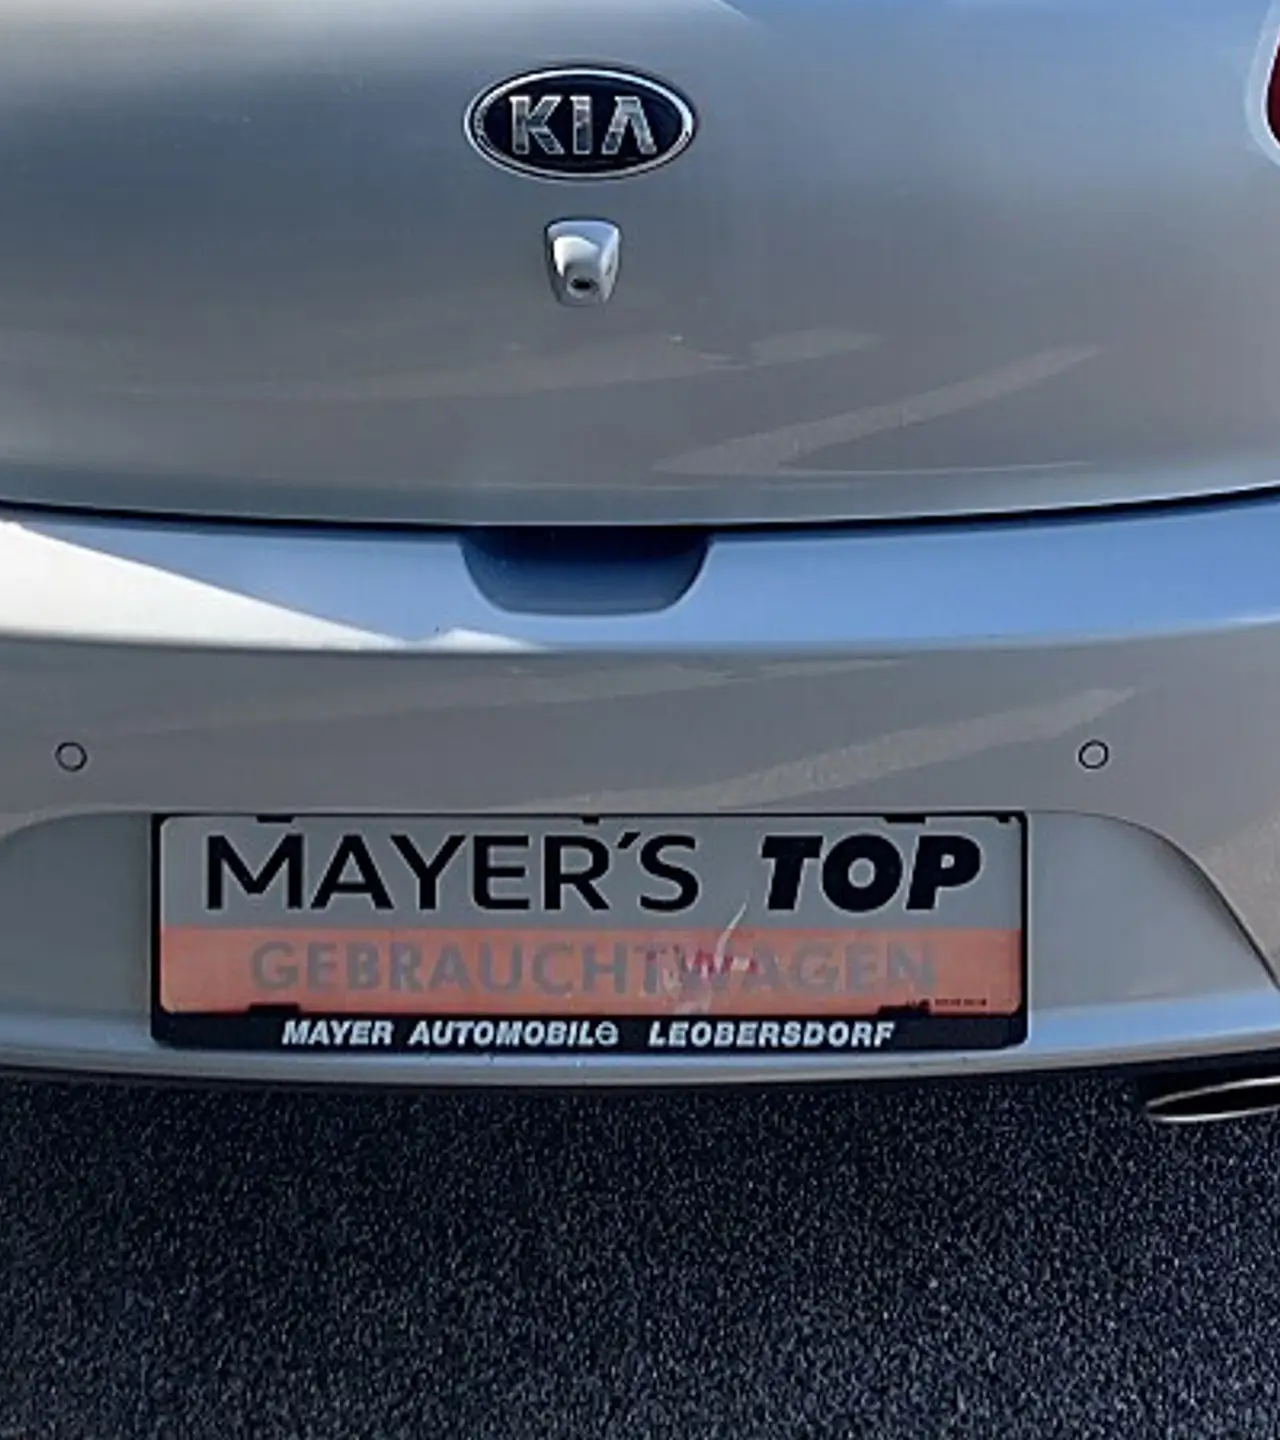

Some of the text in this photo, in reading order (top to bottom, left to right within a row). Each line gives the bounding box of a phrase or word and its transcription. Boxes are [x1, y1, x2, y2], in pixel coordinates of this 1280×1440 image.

[508, 94, 658, 156] KIA
[760, 833, 982, 913] TOP
[251, 940, 937, 997] GEBRAUCHTWAGEN
[281, 1020, 395, 1046] MAYER
[648, 1020, 896, 1048] LEOBERSDORF
